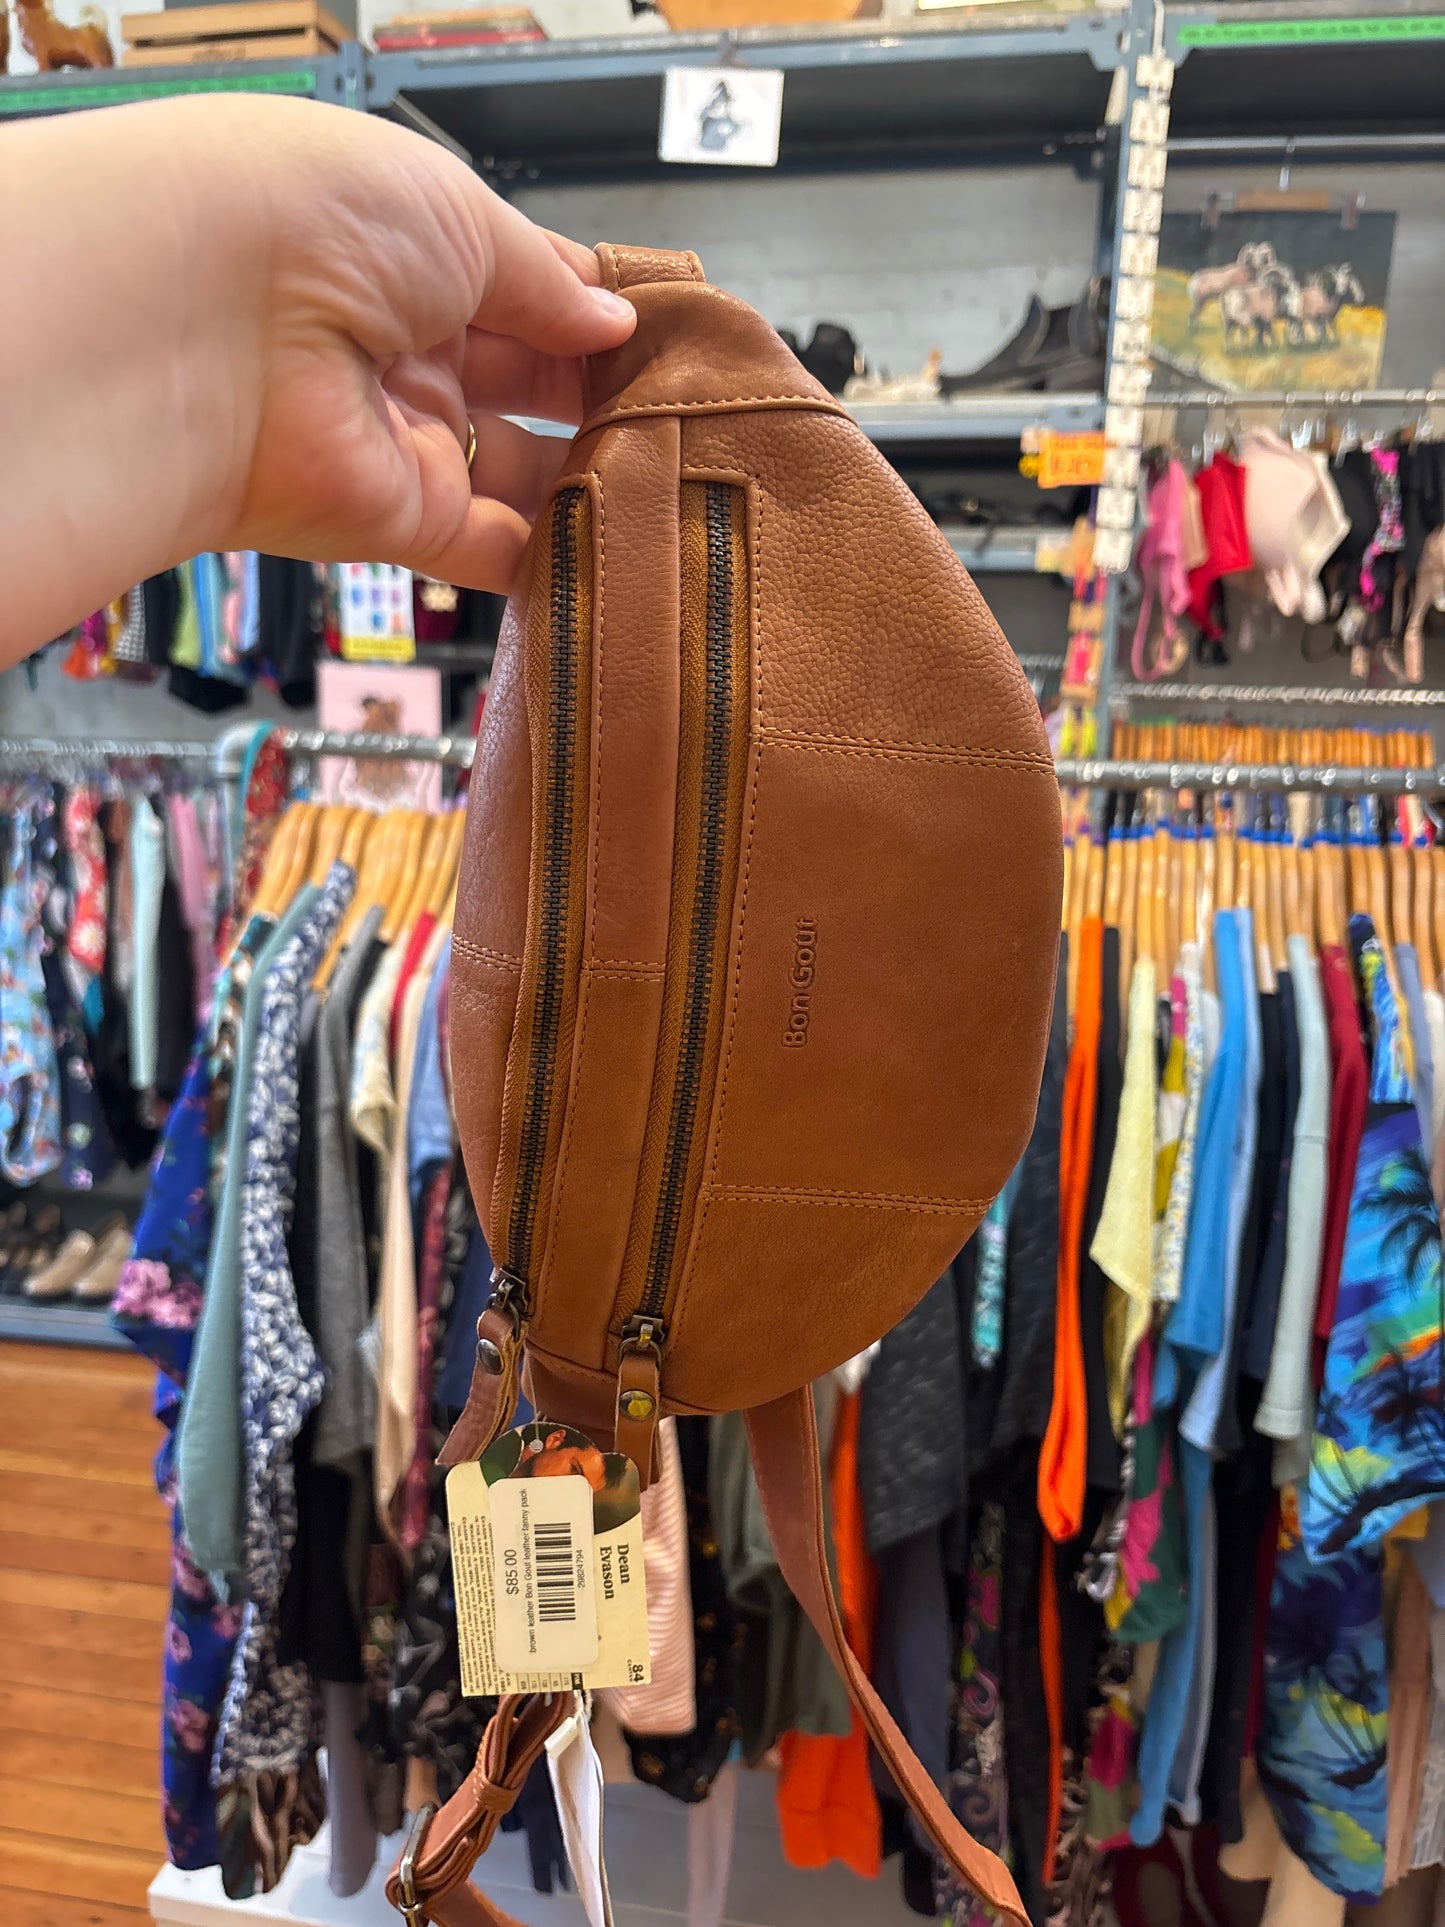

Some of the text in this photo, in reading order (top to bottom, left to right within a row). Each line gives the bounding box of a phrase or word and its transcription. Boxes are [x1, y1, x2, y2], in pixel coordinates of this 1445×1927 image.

[782, 994, 811, 1048] Bon
[520, 1488, 528, 1507] pack
[504, 1549, 519, 1594] $85.00
[576, 1549, 585, 1588] 29824794
[600, 1546, 615, 1599] Evason
[617, 1544, 631, 1584] Dean
[525, 1583, 533, 1598] Bon
[527, 1601, 535, 1626] leather
[632, 1664, 644, 1682] 84
